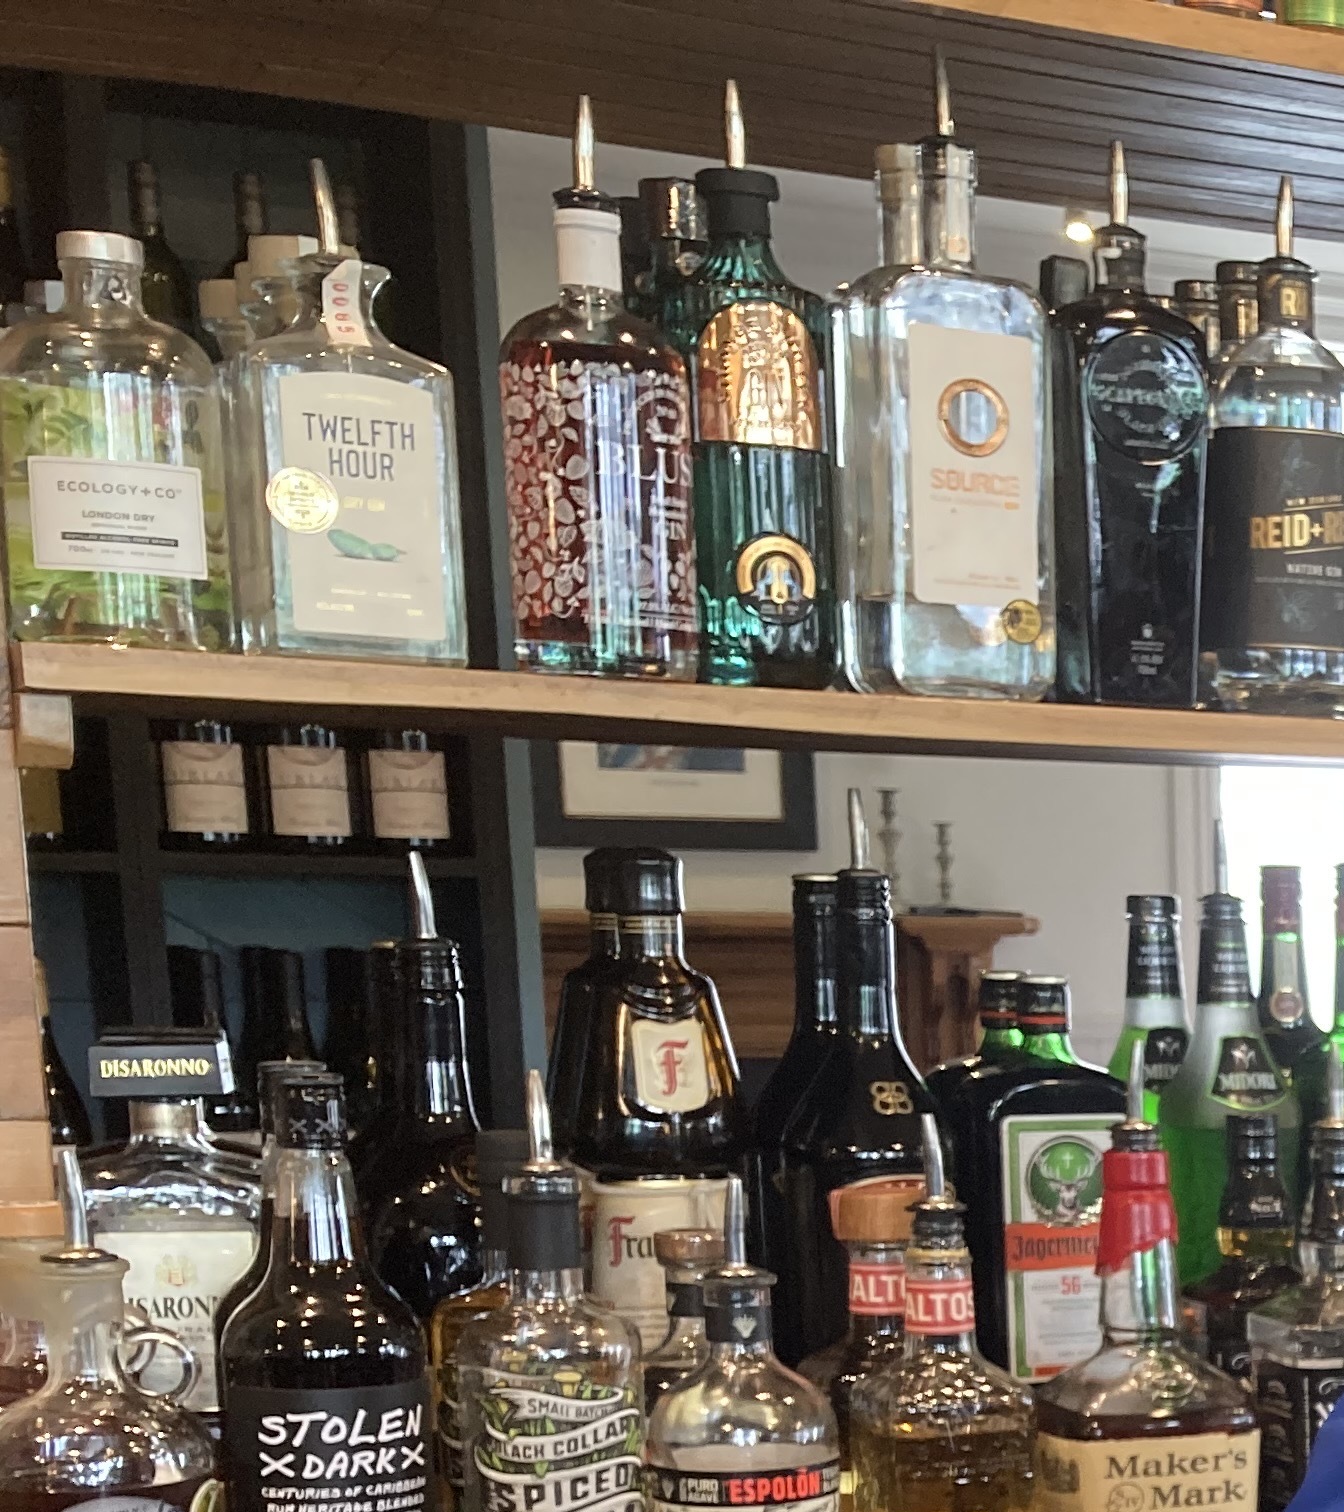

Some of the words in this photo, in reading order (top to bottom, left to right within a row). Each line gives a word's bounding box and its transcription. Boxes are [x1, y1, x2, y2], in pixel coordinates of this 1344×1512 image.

[301, 411, 417, 452] TWELFTH
[327, 446, 395, 482] HOUR
[929, 467, 1021, 498] SOURCE
[81, 510, 131, 521] LONDON
[133, 512, 156, 523] DRY
[99, 1057, 210, 1079] DISARONNO
[257, 1403, 422, 1448] STOLEN
[553, 1416, 632, 1457] COLLAR
[301, 1444, 398, 1481] DARK
[1103, 1448, 1248, 1480] Maker's
[260, 1485, 341, 1500] CENTURIES
[344, 1484, 363, 1498] OF
[1149, 1479, 1247, 1511] Mark
